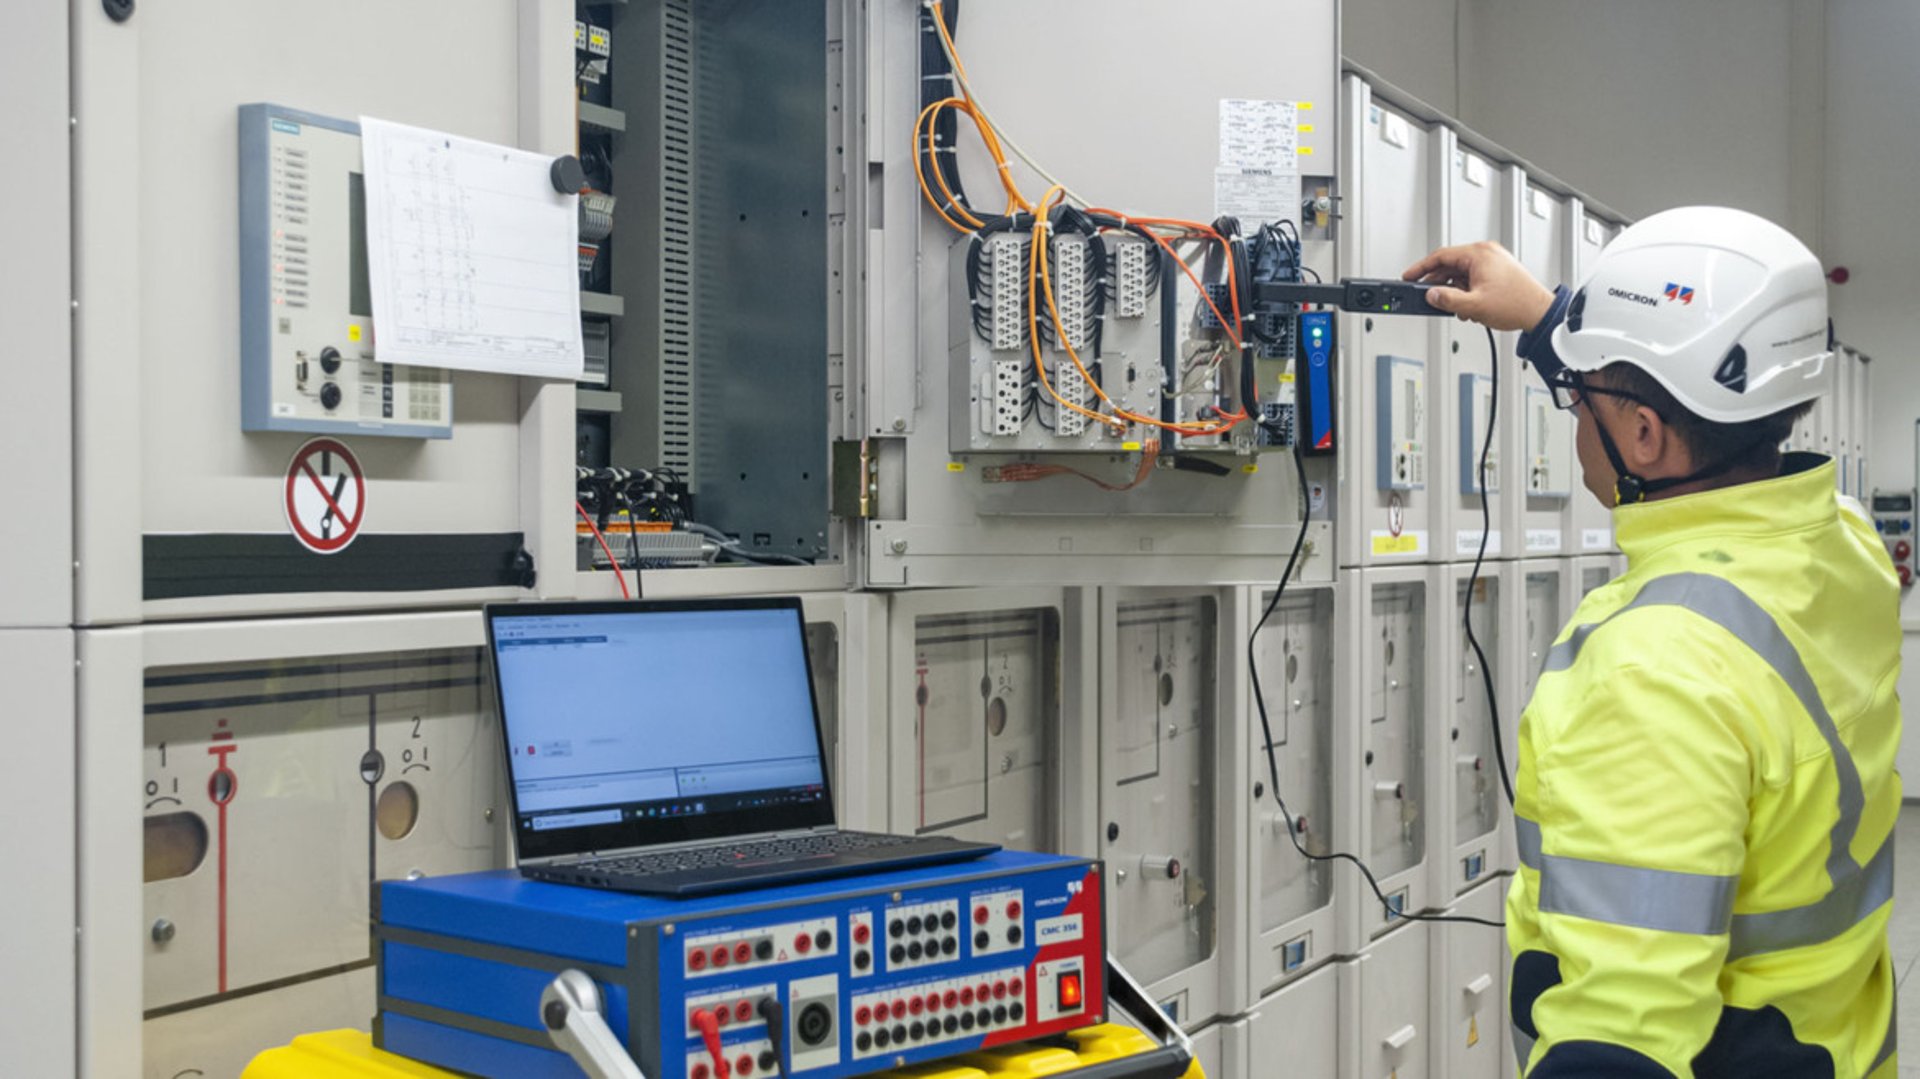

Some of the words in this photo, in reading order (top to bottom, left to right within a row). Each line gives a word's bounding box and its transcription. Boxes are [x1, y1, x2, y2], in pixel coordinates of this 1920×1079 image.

[1608, 287, 1658, 306] OMICRON
[411, 716, 421, 738] 2
[158, 741, 166, 768] 1
[1041, 925, 1060, 936] CMC
